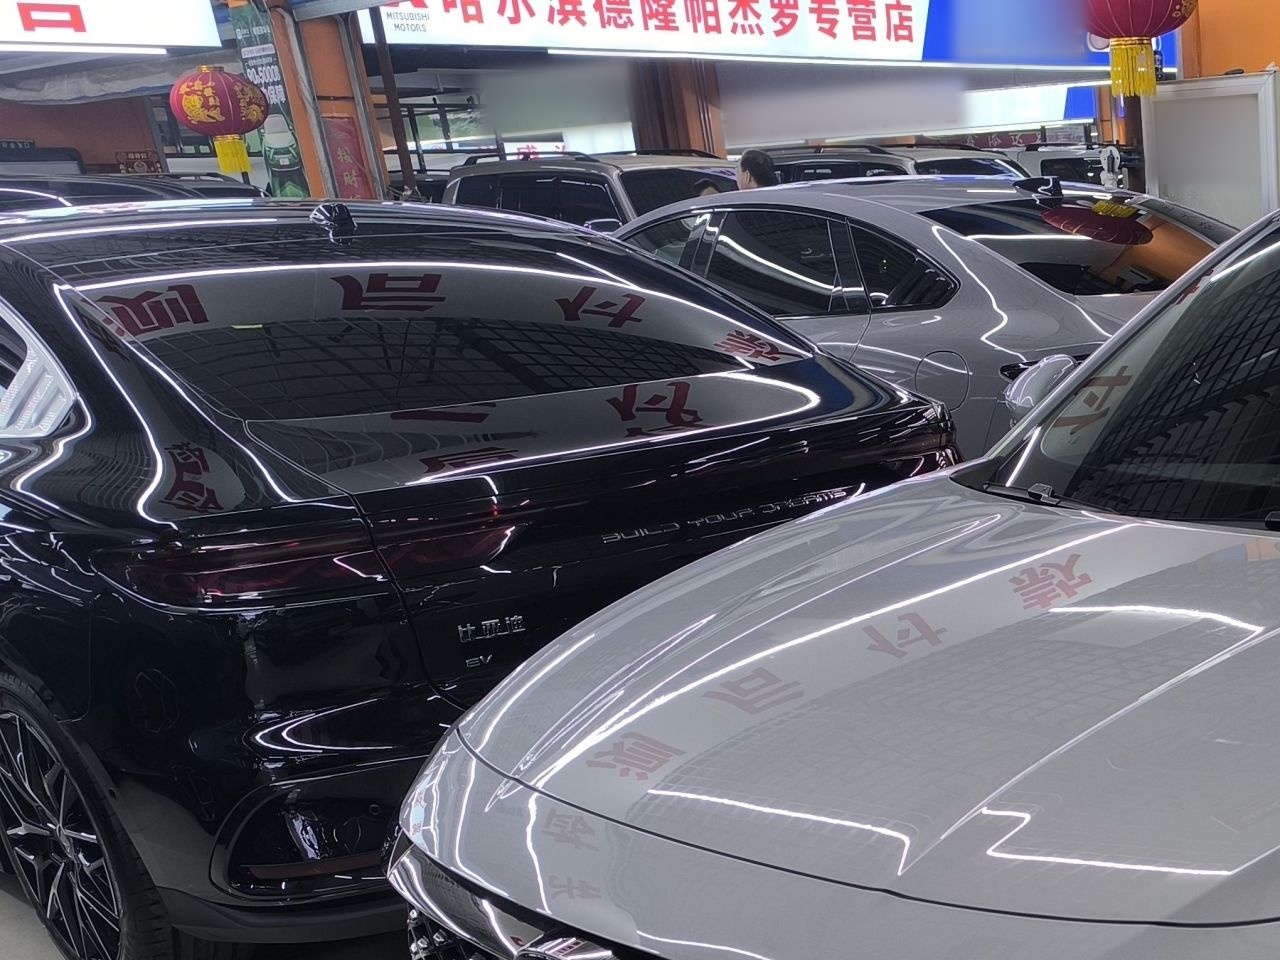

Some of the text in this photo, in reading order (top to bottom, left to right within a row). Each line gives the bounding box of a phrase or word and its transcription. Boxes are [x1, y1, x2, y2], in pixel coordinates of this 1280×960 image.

[386, 11, 430, 21] MITSUBISHI
[394, 23, 427, 32] MOTORS
[603, 489, 846, 544] BUILD YOUR DREAMS
[457, 615, 527, 643] 比亚迪
[466, 654, 492, 669] EV
